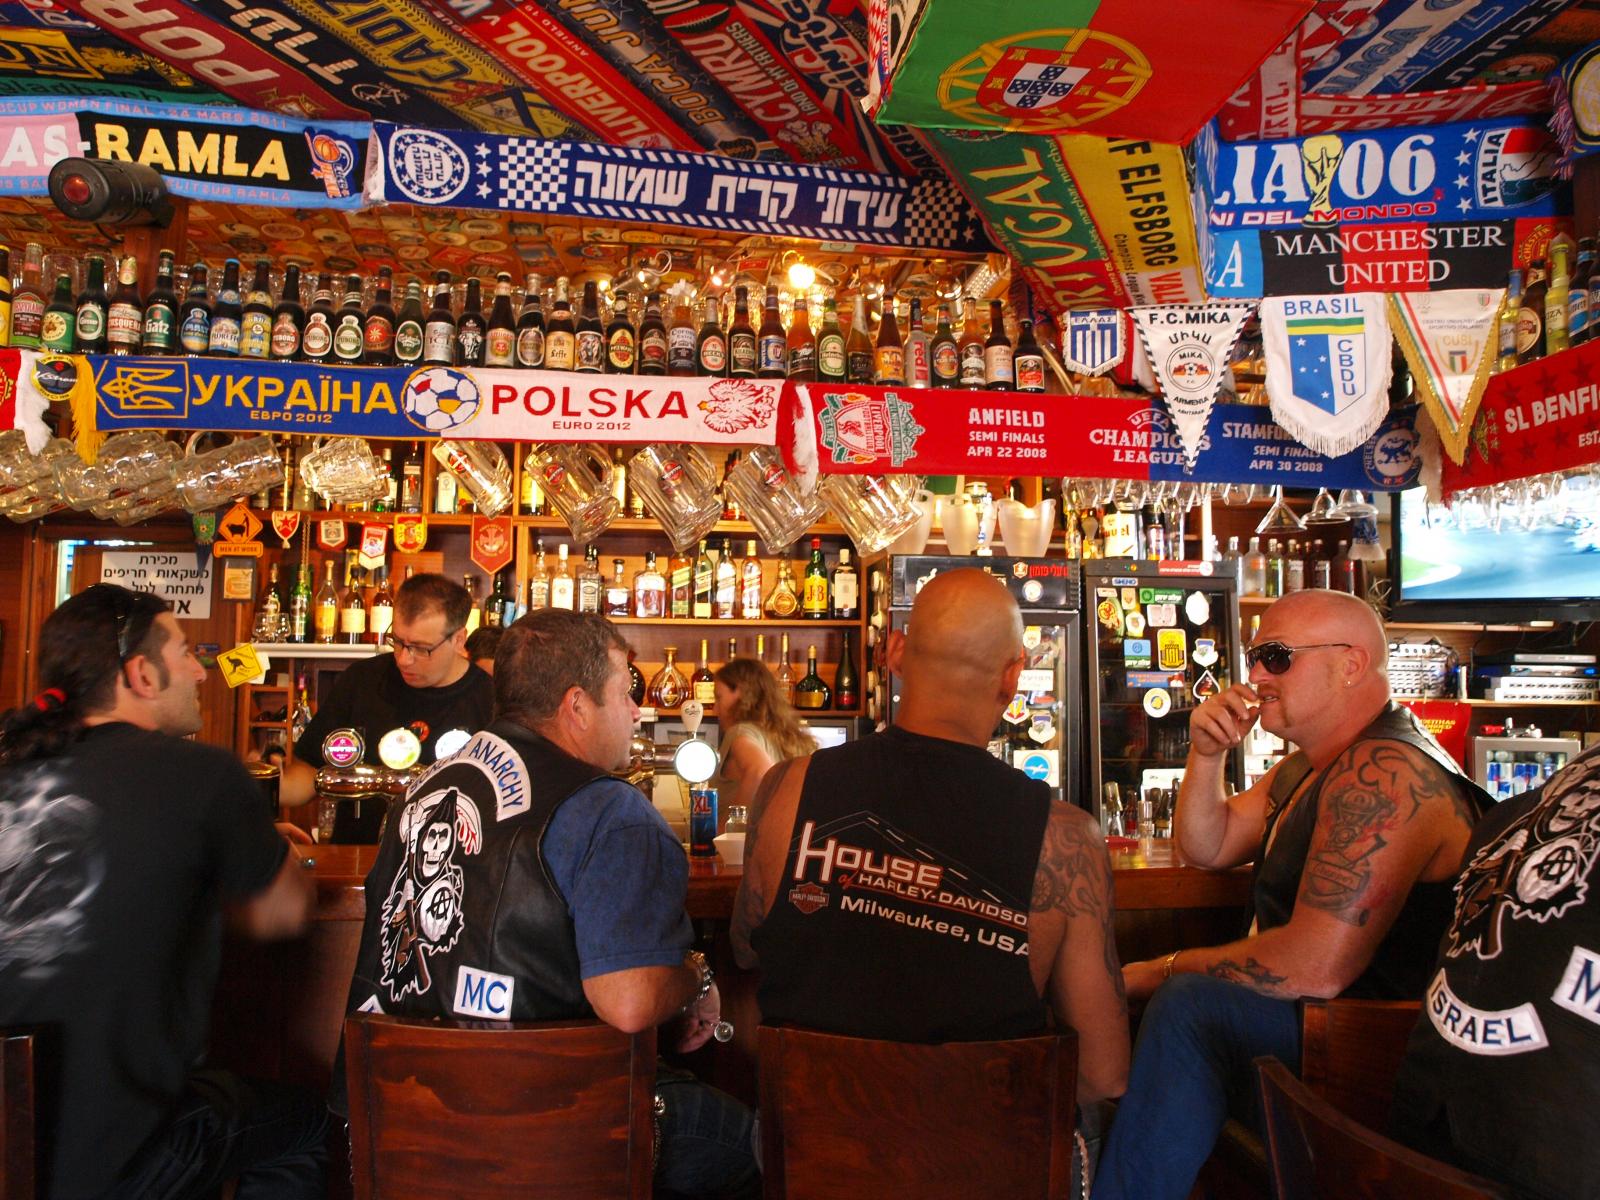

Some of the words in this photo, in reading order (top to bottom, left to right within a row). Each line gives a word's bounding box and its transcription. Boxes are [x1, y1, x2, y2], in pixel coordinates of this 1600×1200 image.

[541, 18, 589, 56] ANFIELD
[726, 21, 775, 68] FATHERS
[493, 21, 650, 143] LIVERPOOL
[632, 52, 725, 126] BOCA
[684, 32, 798, 122] CYMRU
[792, 90, 820, 117] LAND
[1338, 134, 1436, 200] 06
[1479, 132, 1506, 205] ITALIA
[574, 160, 689, 207] שמונה
[706, 174, 798, 222] קרית
[816, 186, 901, 228] עירוני
[1119, 163, 1179, 268] ELFSBORG
[1241, 210, 1296, 226] DEL
[1312, 202, 1437, 222] MONDO
[1274, 226, 1507, 257] MANCHESTER
[1327, 260, 1450, 286] UNITED
[1283, 296, 1365, 317] BRASIL
[145, 319, 169, 336] Gatz
[551, 349, 567, 359] Leffe
[1178, 350, 1204, 361] MIKA
[192, 374, 398, 415] УКРАЇНА
[491, 384, 689, 419] POLSKA
[250, 410, 291, 421] ЕВРО
[295, 413, 333, 424] 2012
[552, 420, 592, 431] EURO
[596, 422, 631, 431] 2012
[870, 404, 884, 452] LIVERPOOL
[968, 408, 1045, 428] ANFIELD
[1129, 411, 1171, 427] UEFA
[1504, 410, 1530, 434] SL
[969, 431, 998, 442] SEMI
[1002, 432, 1045, 444] FINALS
[1253, 445, 1281, 456] SEMI
[967, 446, 992, 457] APR
[997, 447, 1012, 458] 22
[1016, 447, 1047, 459] 2008
[1113, 449, 1185, 466] LEAGUE
[1249, 459, 1273, 471] APR
[1277, 461, 1294, 471] 30
[1298, 461, 1323, 472] 2008
[138, 555, 178, 566] מכירת
[104, 568, 147, 580] חריפים
[165, 585, 204, 595] מתחת
[468, 737, 523, 809] ANARCHY
[693, 796, 711, 814] XL
[840, 895, 971, 943] Milwaukee,
[461, 973, 508, 1014] MC
[1430, 981, 1513, 1046] ISRAEL
